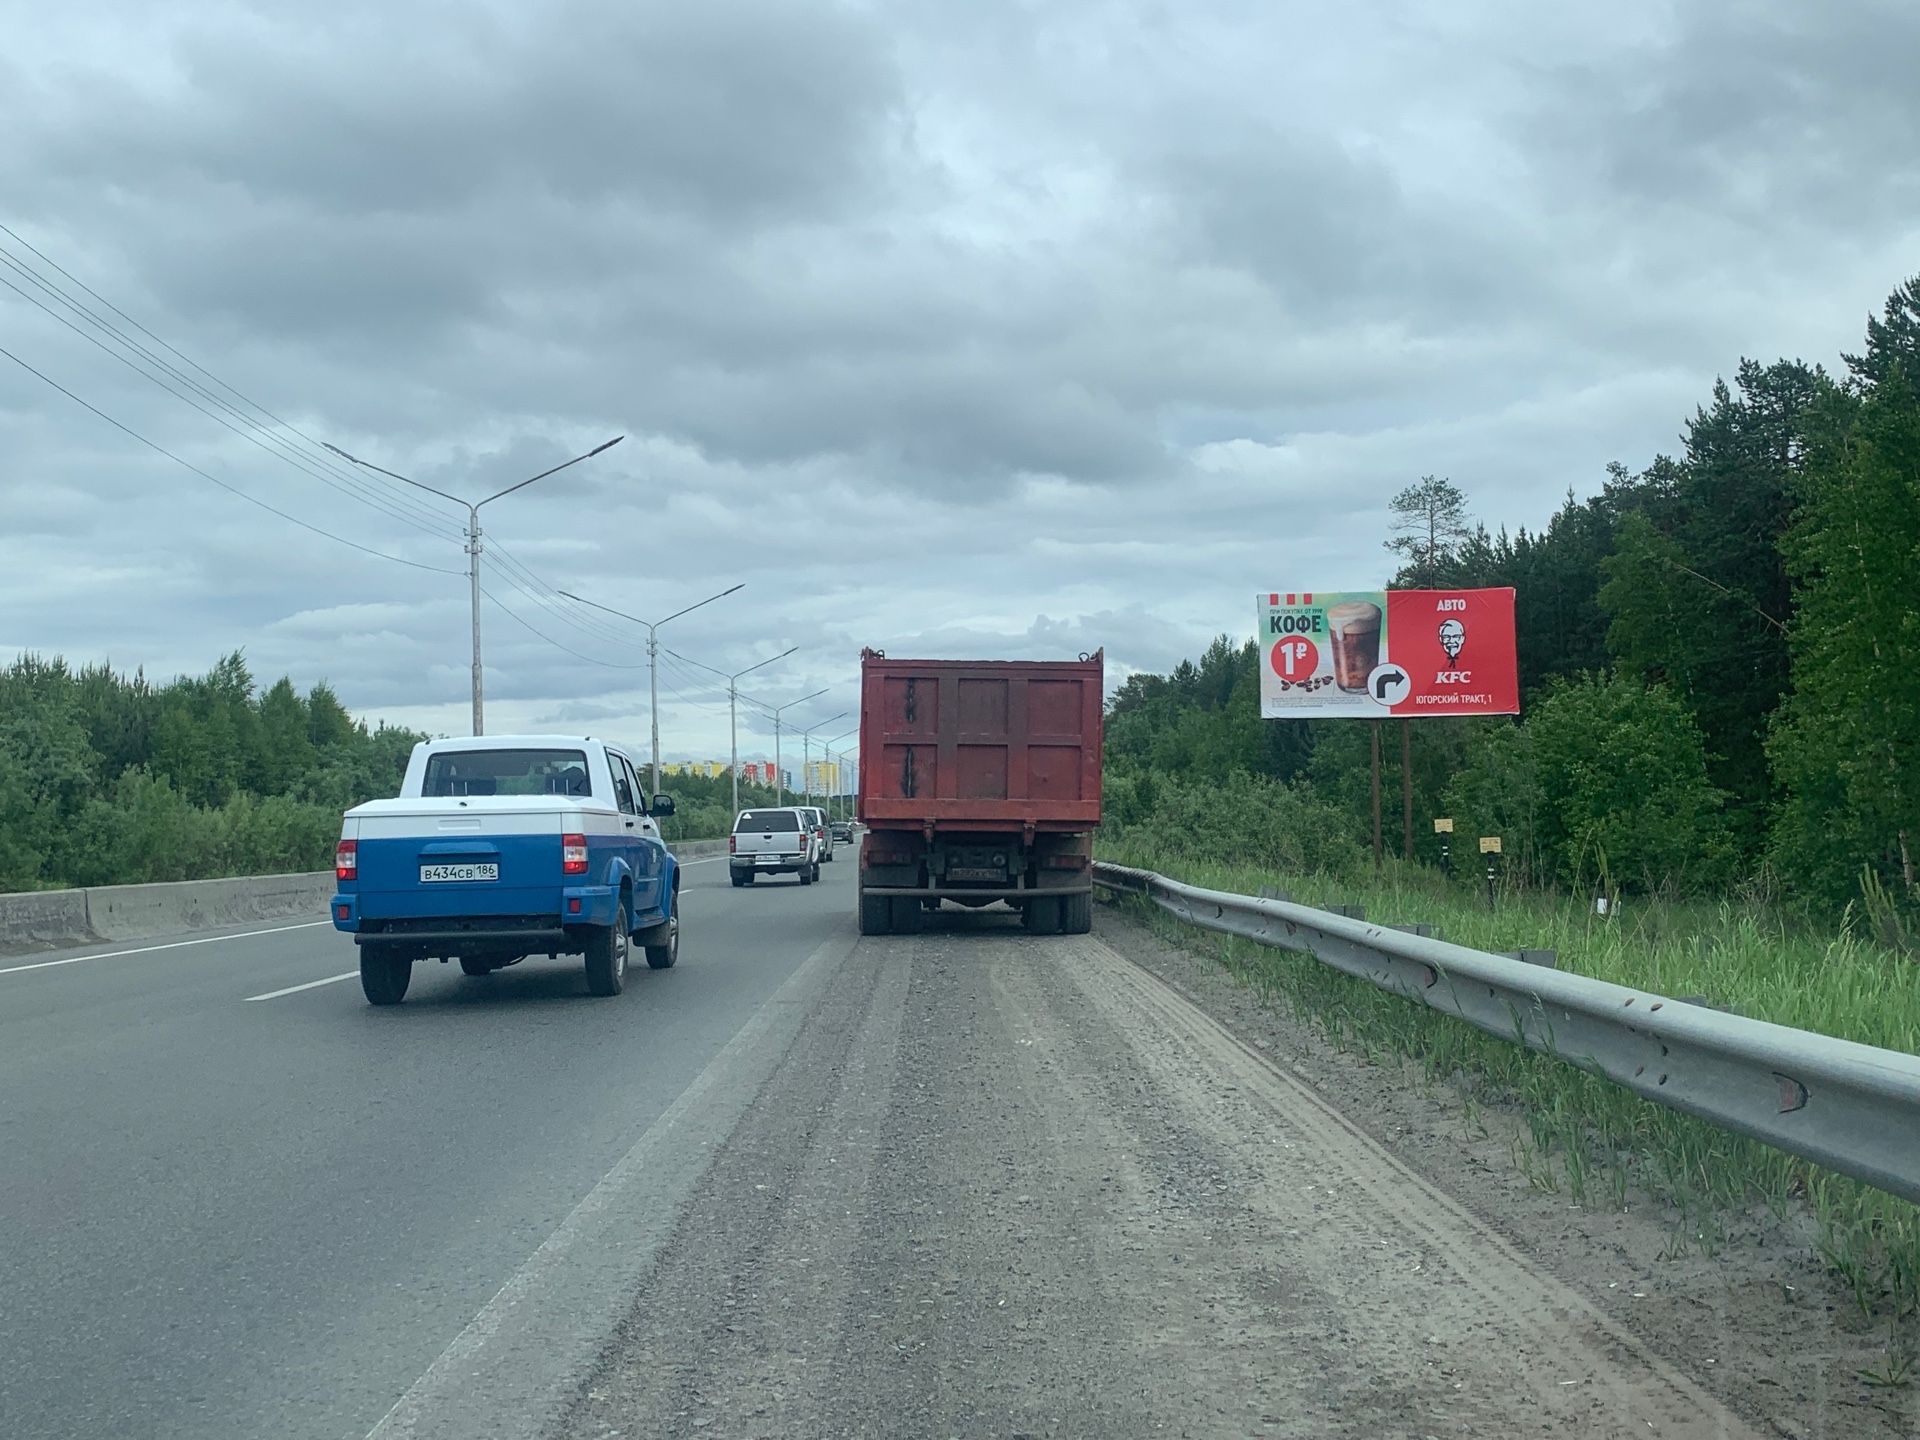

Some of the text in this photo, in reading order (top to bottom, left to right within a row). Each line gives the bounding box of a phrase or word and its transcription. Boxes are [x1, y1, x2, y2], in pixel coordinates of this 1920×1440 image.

[1436, 599, 1467, 612] АВТО
[1270, 615, 1322, 634] КОФЕ
[1435, 671, 1472, 684] KFC
[1416, 692, 1492, 705] ЮГОРСКИЙ ТРАКТ, 1
[476, 865, 495, 874] 186
